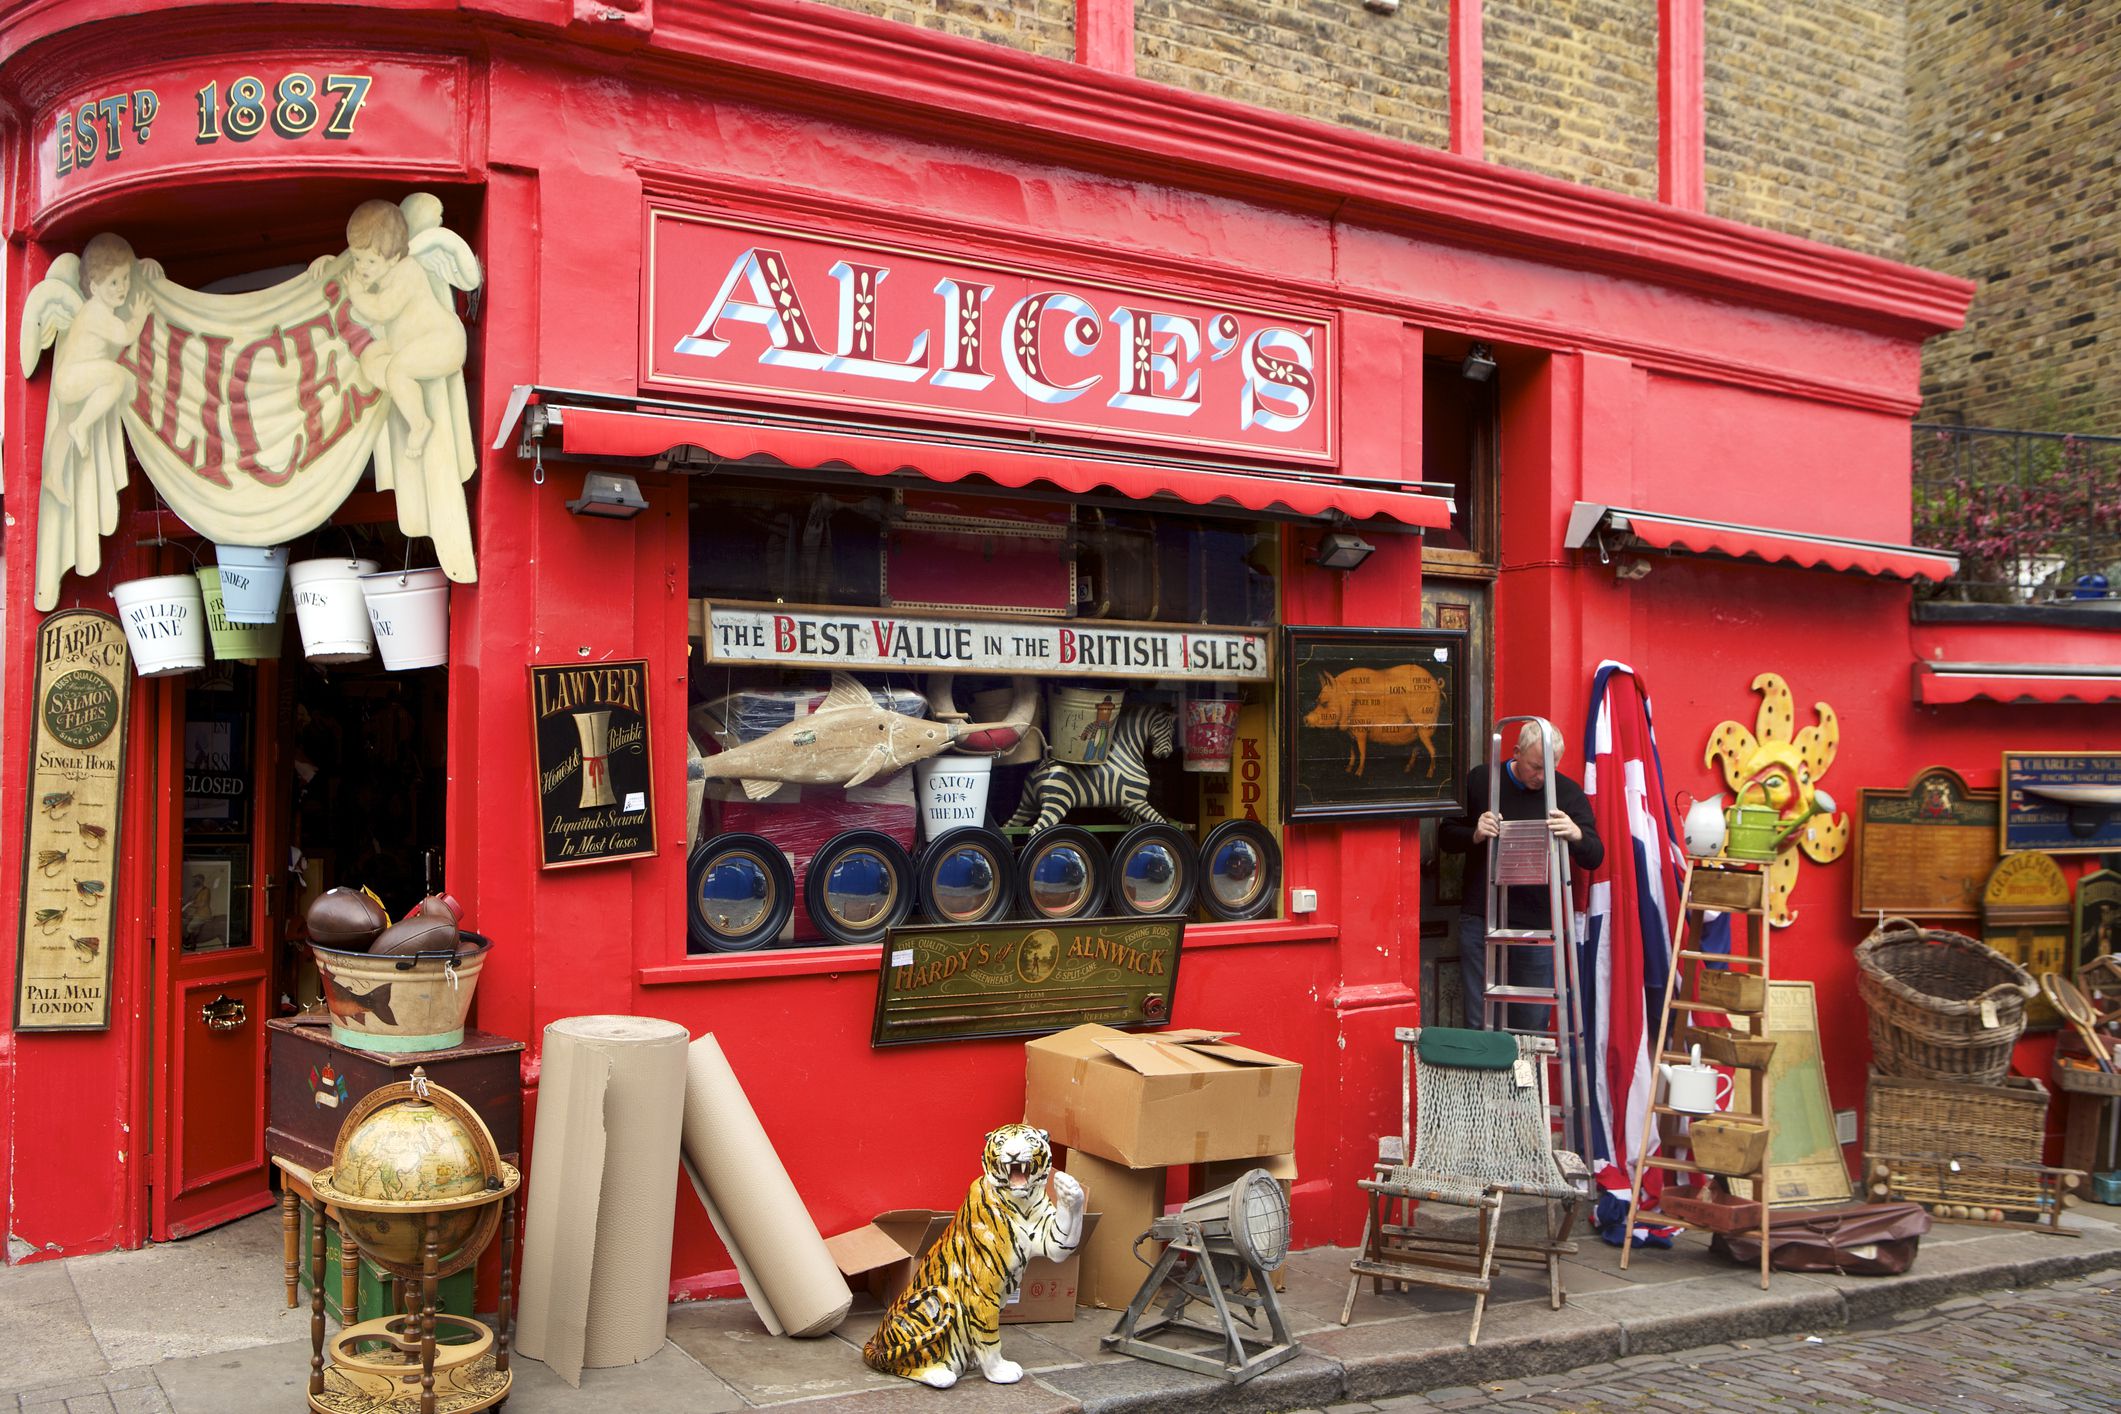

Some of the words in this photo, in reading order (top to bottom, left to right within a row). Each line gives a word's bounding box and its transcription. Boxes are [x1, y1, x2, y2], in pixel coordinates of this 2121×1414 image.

[195, 72, 373, 143] 1887
[673, 245, 1318, 433] ALICE'S
[129, 603, 188, 625] MULLED
[135, 618, 184, 641] WINE
[719, 624, 765, 647] THE
[773, 615, 860, 656] BEST
[871, 620, 973, 661] VALUE
[984, 635, 1002, 656] IN
[1012, 637, 1050, 658] THE
[1059, 629, 1168, 668] BRITISH
[1180, 634, 1258, 672] ISLES
[55, 674, 73, 690] BEST
[72, 671, 106, 689] QUALITY
[1389, 686, 1407, 695] LOIN
[48, 690, 113, 716] SALMON
[538, 668, 643, 718] LAWYER
[56, 705, 107, 729] FLIES
[59, 732, 83, 745] SINCE
[607, 722, 645, 751] Reliable
[36, 751, 83, 770] SINGLE
[84, 751, 117, 771] HOOK
[929, 776, 975, 791] CATCH
[943, 792, 959, 803] OF
[549, 811, 605, 838] Acquittals
[605, 807, 649, 830] Secured
[929, 808, 952, 820] THE
[953, 807, 978, 820] DAY
[559, 837, 575, 856] In
[574, 834, 607, 856] Most
[608, 832, 639, 851] Cases
[1124, 928, 1150, 943] FISHING
[1152, 926, 1171, 938] RODS
[918, 938, 949, 954] QUALITY
[893, 942, 991, 992] HARDY'S
[1067, 935, 1169, 977] ALNWICK
[970, 969, 1014, 985] GREENHEART
[26, 985, 61, 1000] PALL
[64, 985, 102, 999] MALL
[31, 1002, 95, 1014] LONDON
